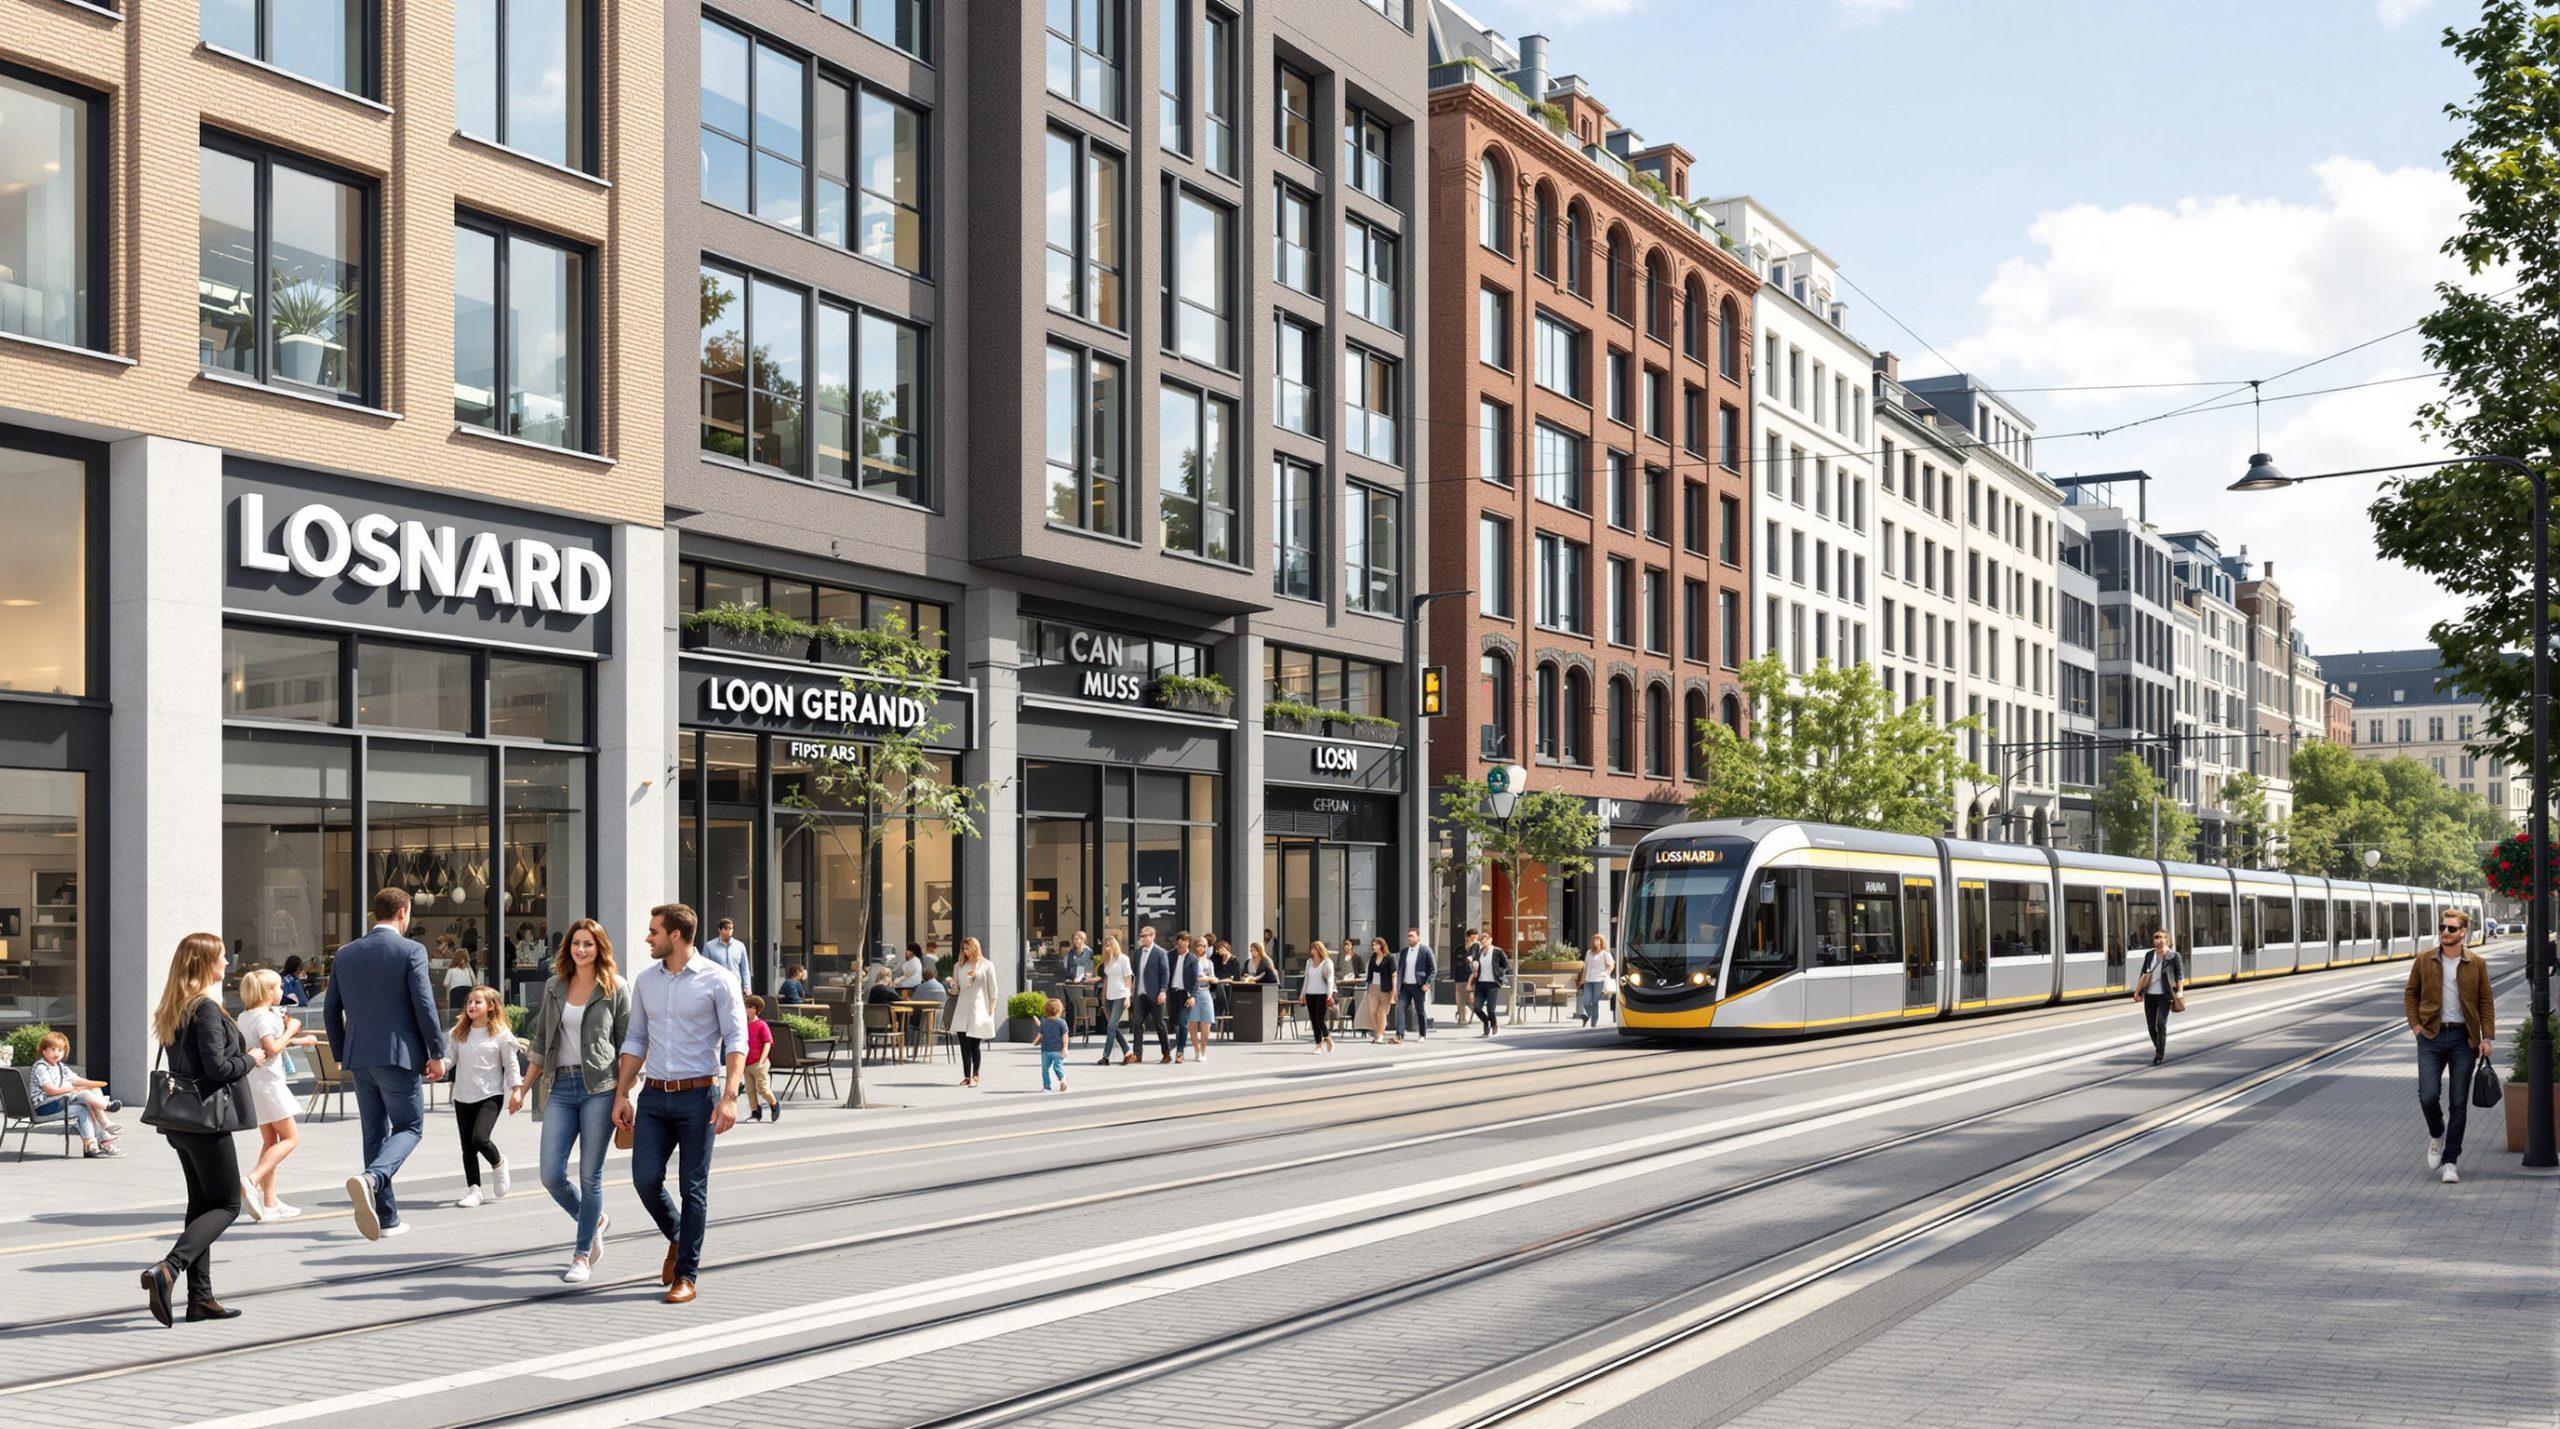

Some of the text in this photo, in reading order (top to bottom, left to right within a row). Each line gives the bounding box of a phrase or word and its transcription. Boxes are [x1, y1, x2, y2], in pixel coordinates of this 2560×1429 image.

[240, 492, 612, 616] LOSNARD
[1070, 631, 1123, 667] CAN
[709, 677, 794, 718] LOON
[1083, 670, 1140, 700] MUSS
[830, 744, 856, 761] ARS
[1316, 746, 1358, 771] LOSN
